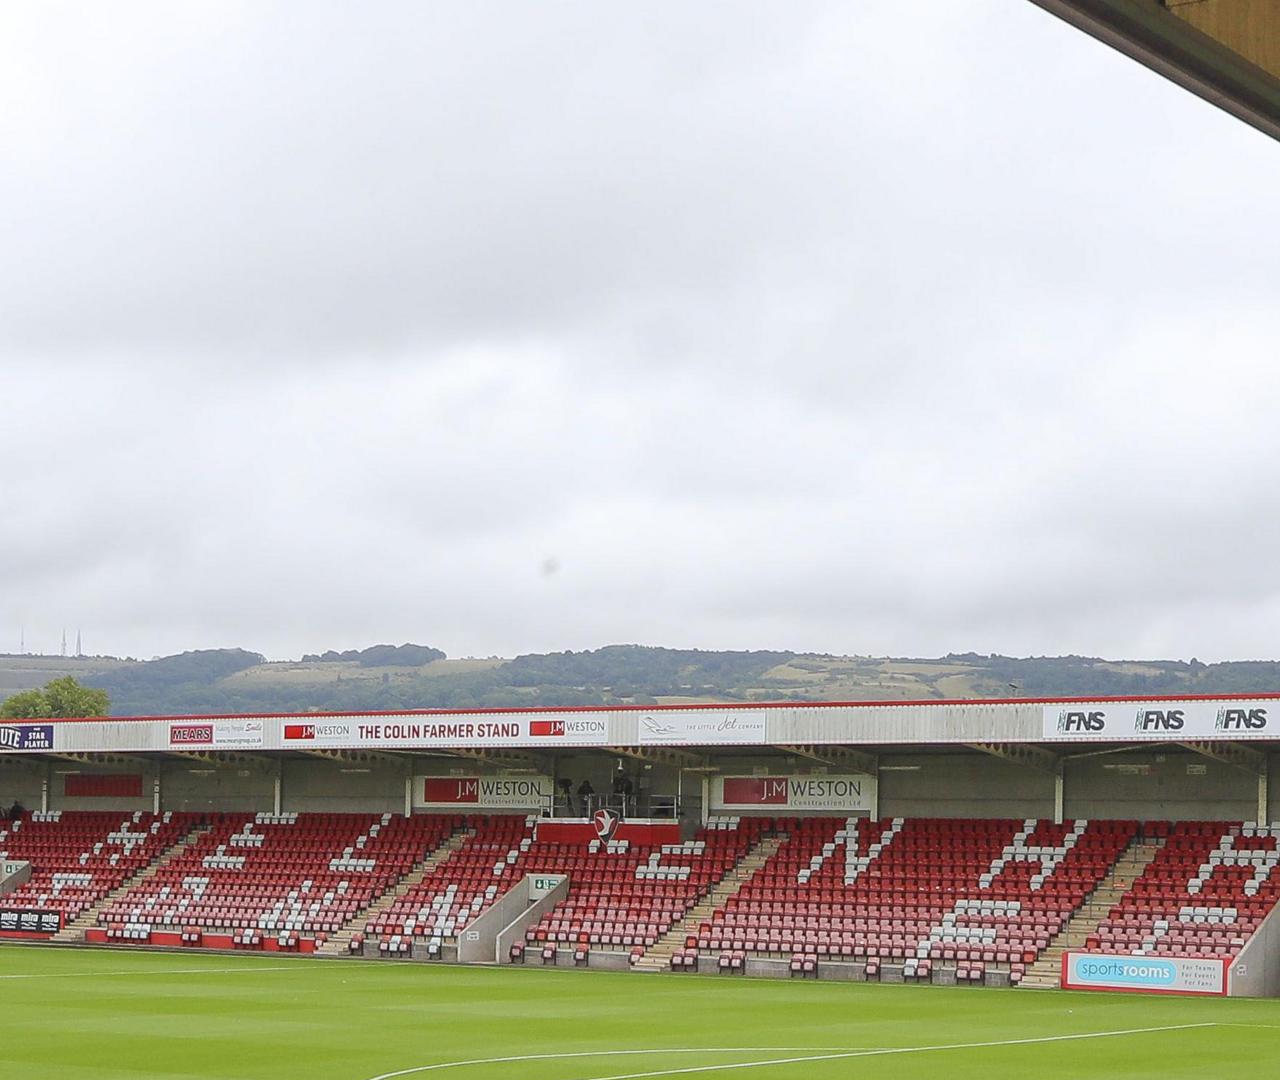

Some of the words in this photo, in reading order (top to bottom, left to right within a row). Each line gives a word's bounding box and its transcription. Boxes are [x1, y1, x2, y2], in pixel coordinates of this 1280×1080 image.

[566, 721, 605, 732] WESTON
[1065, 711, 1106, 732] FNS
[1142, 710, 1185, 731] FNS
[1224, 708, 1267, 730] FNS
[172, 728, 211, 741] MEARS
[316, 726, 350, 736] WESTON
[358, 726, 381, 739] THE
[384, 725, 420, 739] COLIN
[423, 724, 474, 738] FARMER
[477, 723, 520, 737] STAND
[25, 740, 50, 748] PLAYER
[456, 781, 478, 800] J.M
[481, 781, 540, 796] WESTON
[761, 781, 787, 800] J.M
[790, 780, 861, 797] WESTON
[790, 799, 845, 807] (Construction)
[849, 799, 861, 807] Ltd
[1083, 963, 1170, 978] sportsrooms
